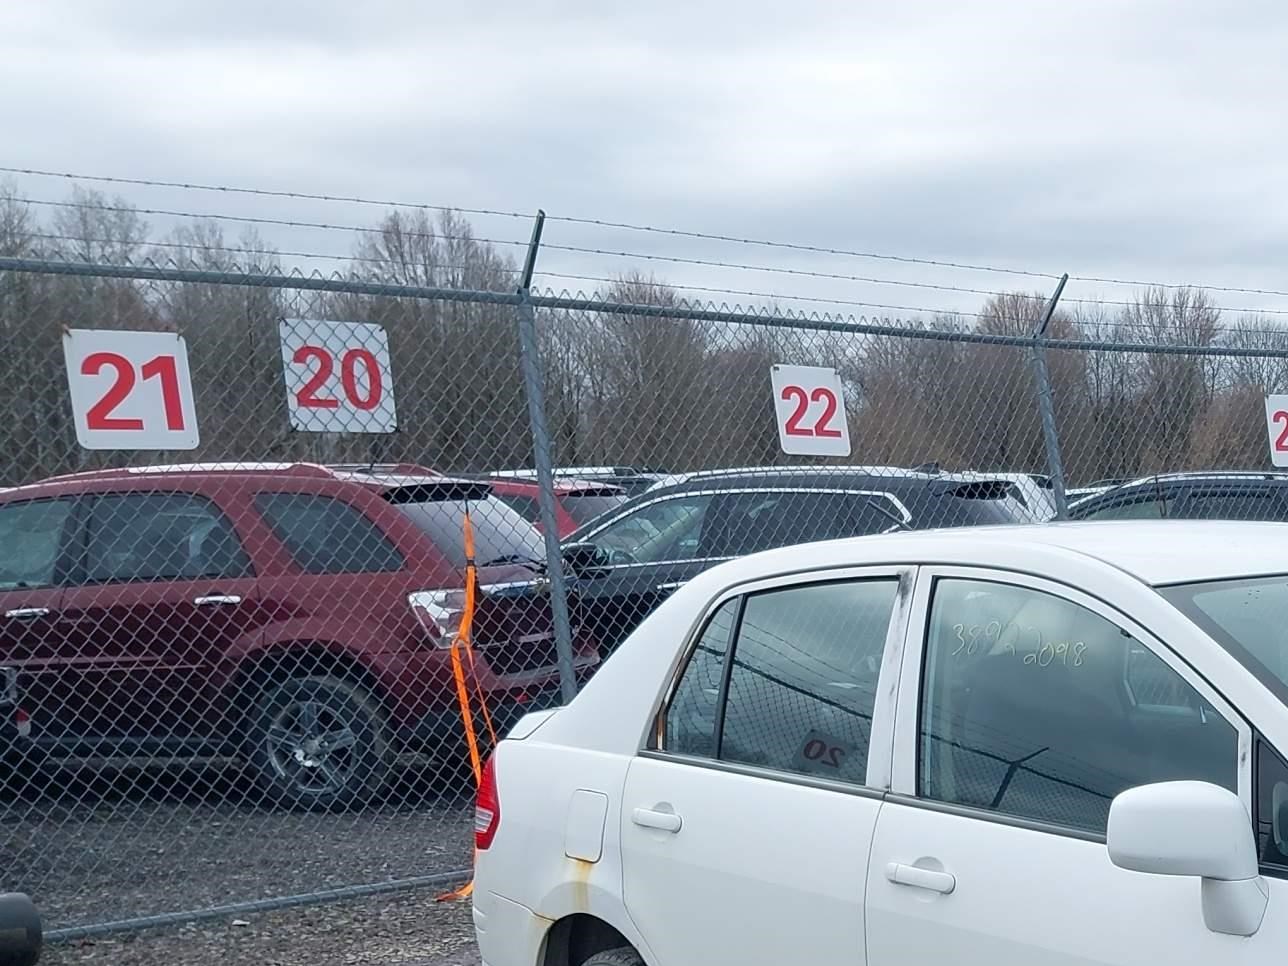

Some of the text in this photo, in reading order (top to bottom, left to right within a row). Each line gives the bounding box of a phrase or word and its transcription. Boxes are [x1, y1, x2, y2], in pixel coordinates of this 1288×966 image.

[80, 351, 186, 431] 21
[292, 345, 383, 411] 20
[781, 384, 842, 438] 22
